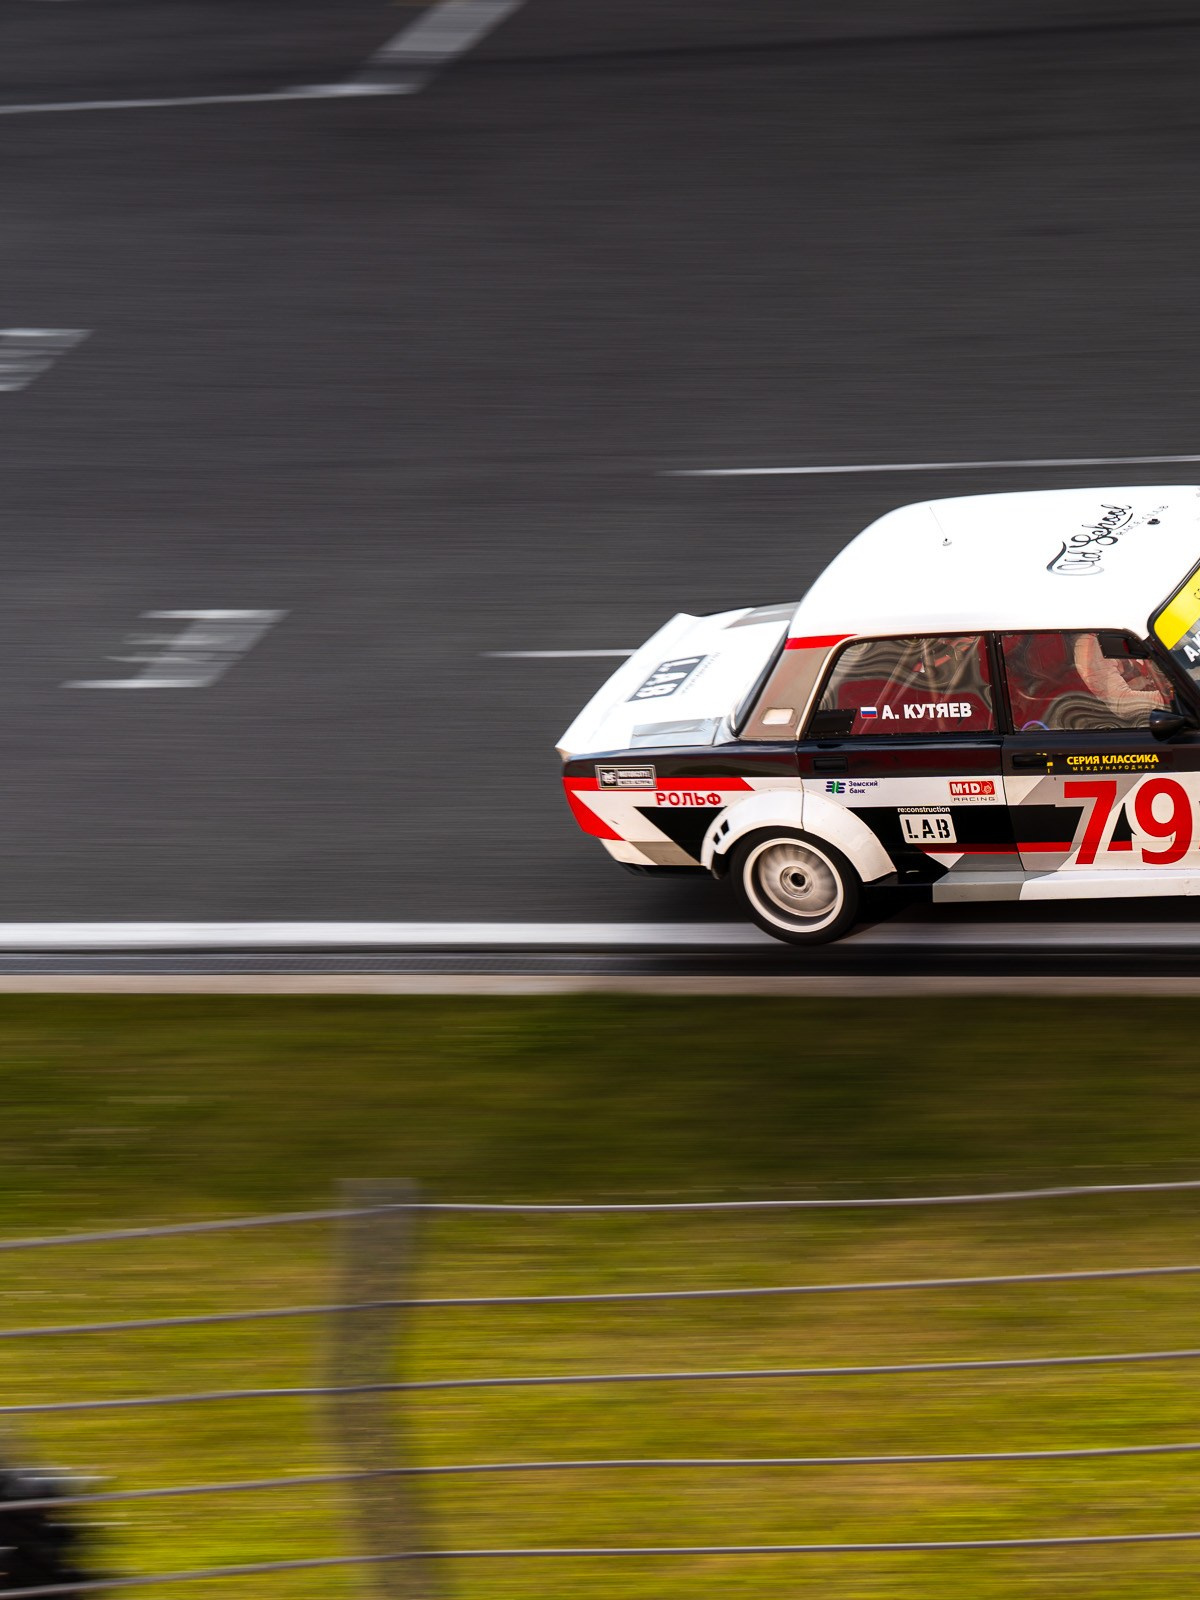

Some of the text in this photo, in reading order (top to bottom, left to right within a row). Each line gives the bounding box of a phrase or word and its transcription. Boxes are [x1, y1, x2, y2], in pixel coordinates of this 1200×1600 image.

[881, 702, 972, 720] А. КУТЯЕВ
[1066, 754, 1160, 766] СЕРИЯ КЛАССИКА
[655, 793, 722, 806] РОЛЬФ
[897, 806, 951, 814] re:construction
[904, 818, 951, 839] LAB
[1064, 777, 1193, 865] 79
